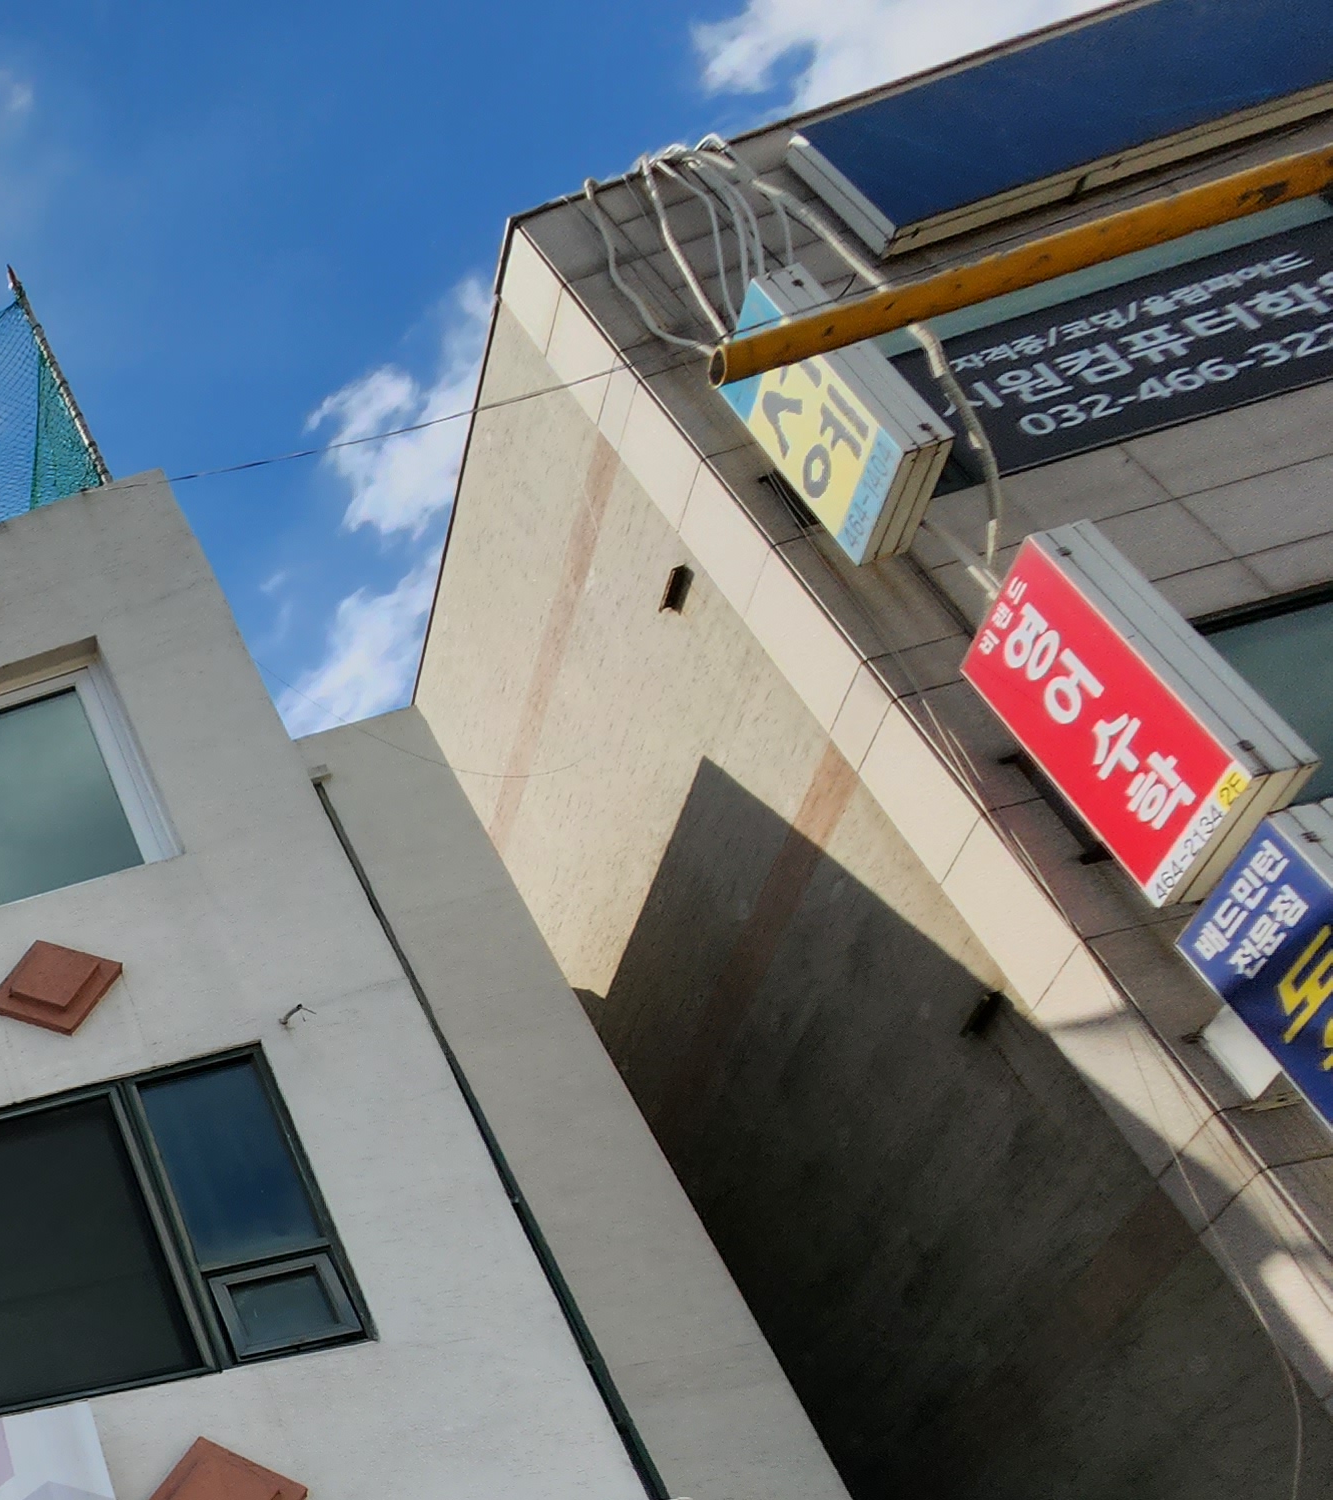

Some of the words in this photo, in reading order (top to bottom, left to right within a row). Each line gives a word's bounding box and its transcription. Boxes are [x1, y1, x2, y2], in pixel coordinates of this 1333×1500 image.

[942, 272, 1333, 417] 시원컴퓨터학
[844, 440, 901, 549] 464-1404
[1004, 601, 1104, 724] 영어
[1092, 713, 1196, 830] 수학
[1155, 803, 1223, 900] 464-2134
[1193, 839, 1290, 961] 배드민턴
[1225, 884, 1309, 979] 전문점
